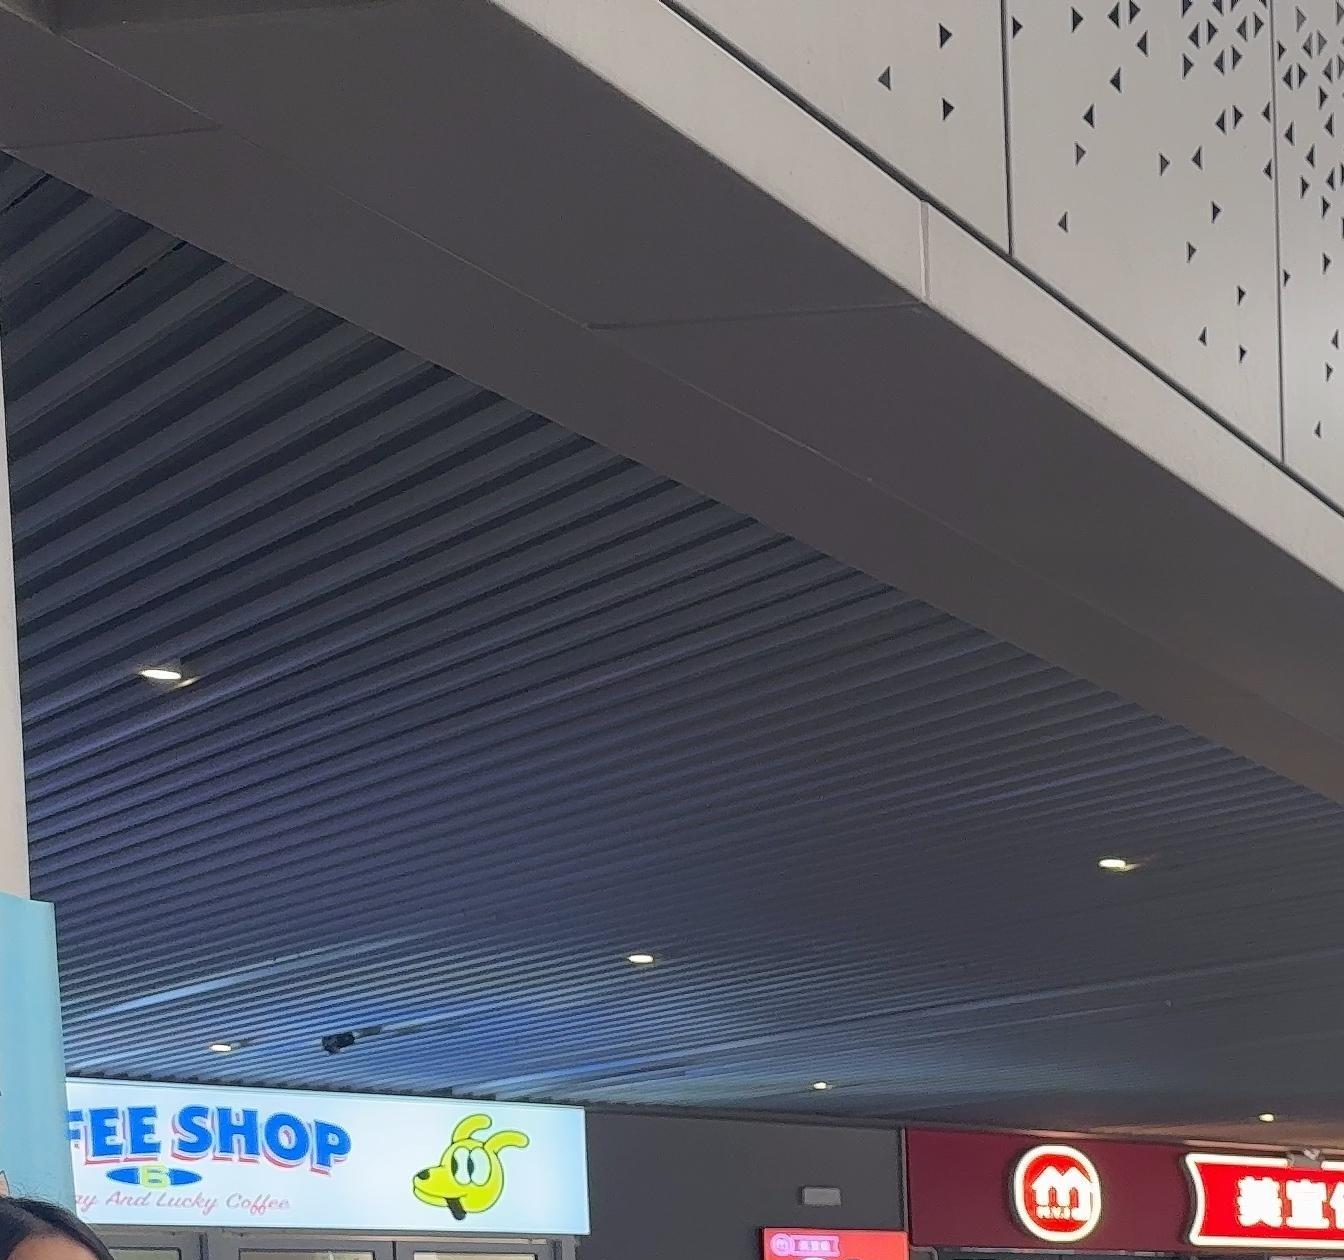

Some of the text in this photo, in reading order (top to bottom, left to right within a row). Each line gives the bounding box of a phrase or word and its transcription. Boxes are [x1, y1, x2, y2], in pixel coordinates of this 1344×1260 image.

[173, 1105, 351, 1174] SHOP
[105, 1190, 151, 1207] And
[156, 1192, 218, 1215] Lucky
[225, 1193, 290, 1215] Coffee
